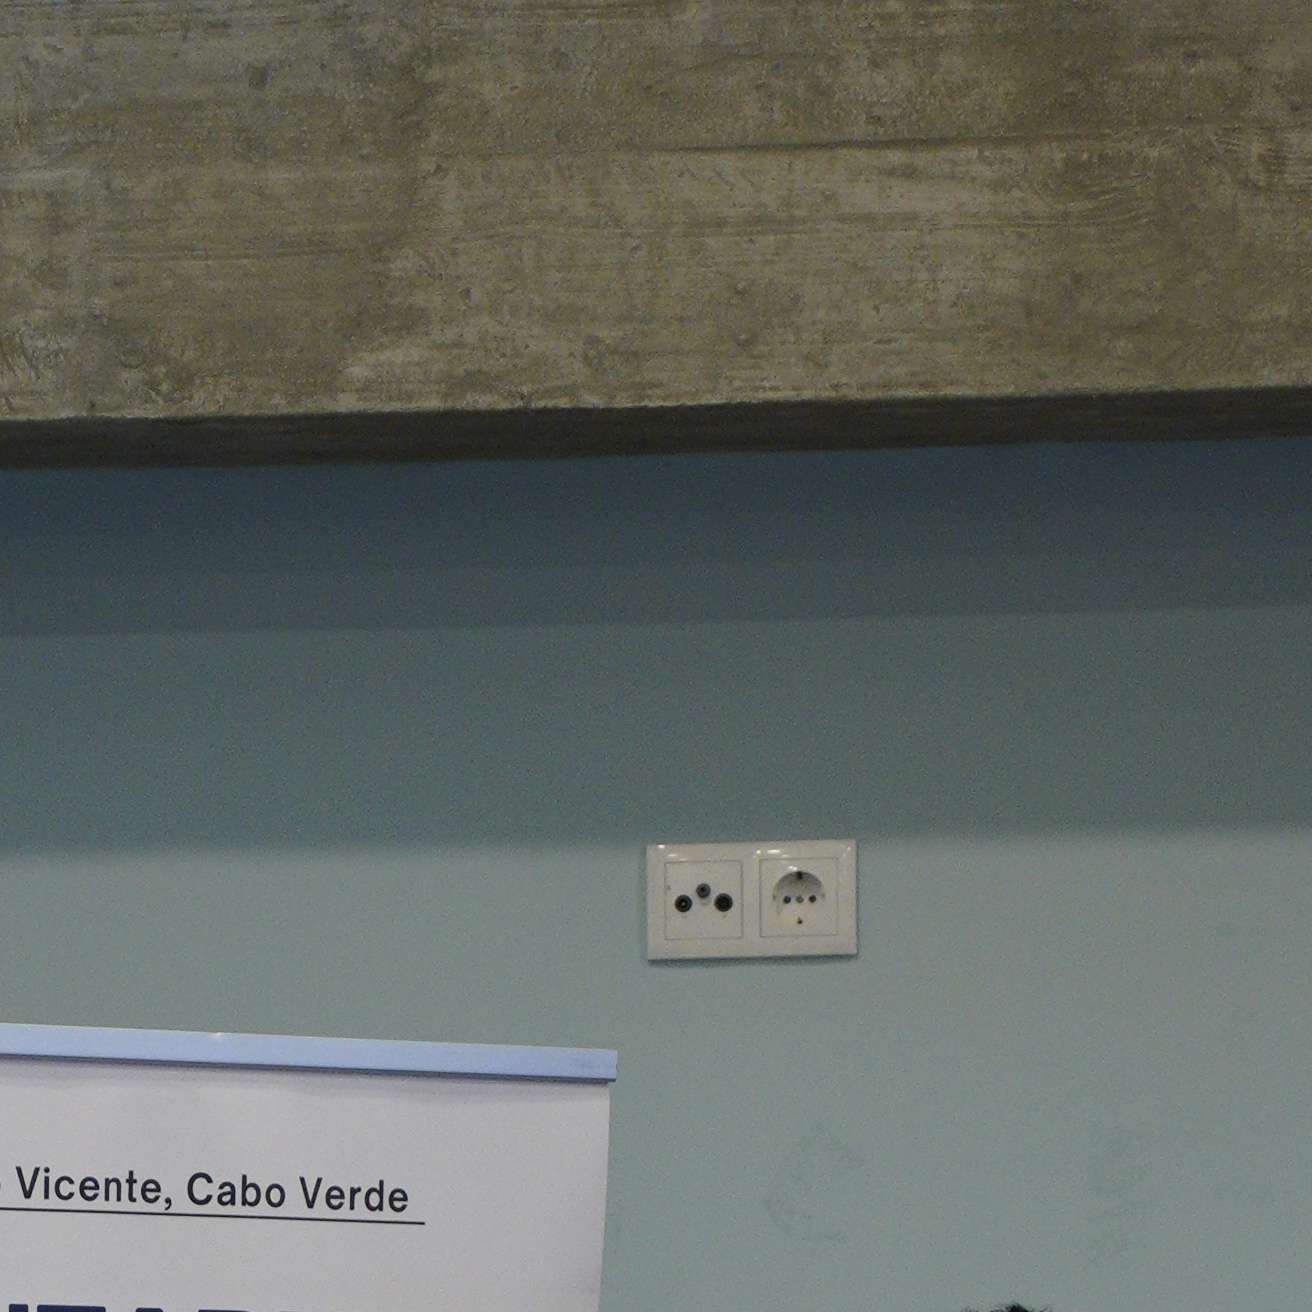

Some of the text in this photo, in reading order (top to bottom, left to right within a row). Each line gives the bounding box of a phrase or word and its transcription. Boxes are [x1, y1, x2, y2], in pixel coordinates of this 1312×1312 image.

[16, 1166, 172, 1210] Vicente,
[187, 1172, 286, 1208] Cabo
[299, 1176, 409, 1213] Verde
